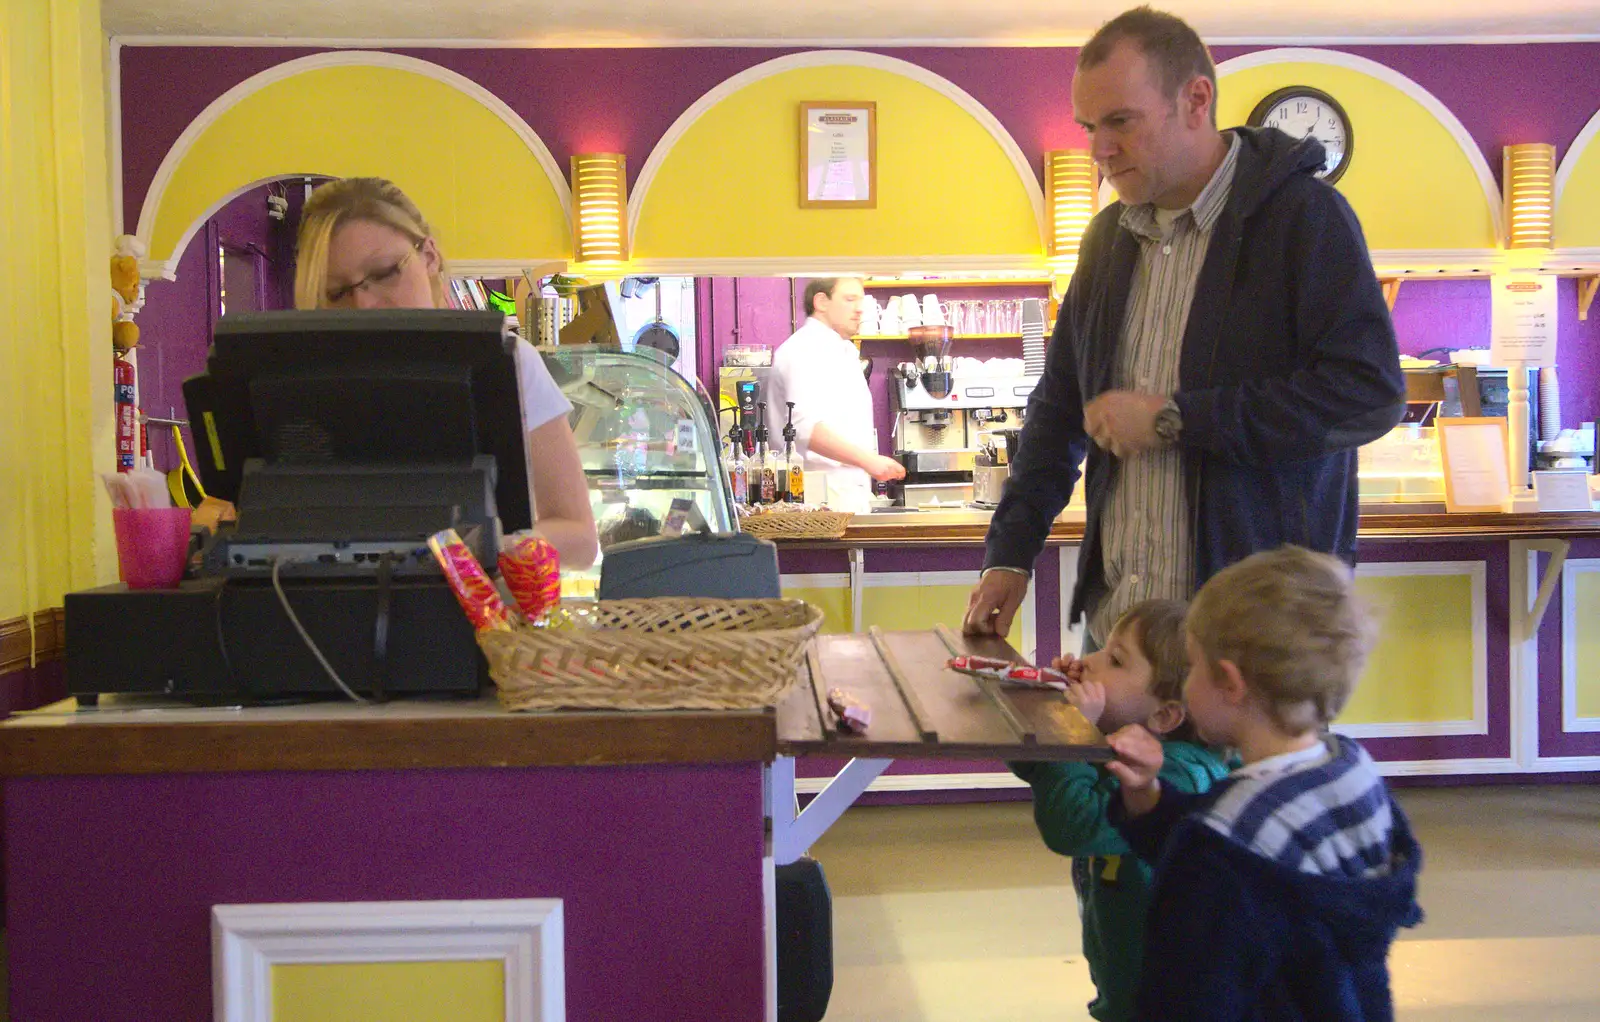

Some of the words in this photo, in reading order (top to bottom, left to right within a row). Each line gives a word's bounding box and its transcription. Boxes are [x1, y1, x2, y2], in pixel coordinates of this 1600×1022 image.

[1279, 107, 1288, 119] 11
[1296, 101, 1308, 114] 12
[1316, 106, 1320, 118] 1
[1268, 120, 1280, 129] 10
[1328, 118, 1336, 130] 2
